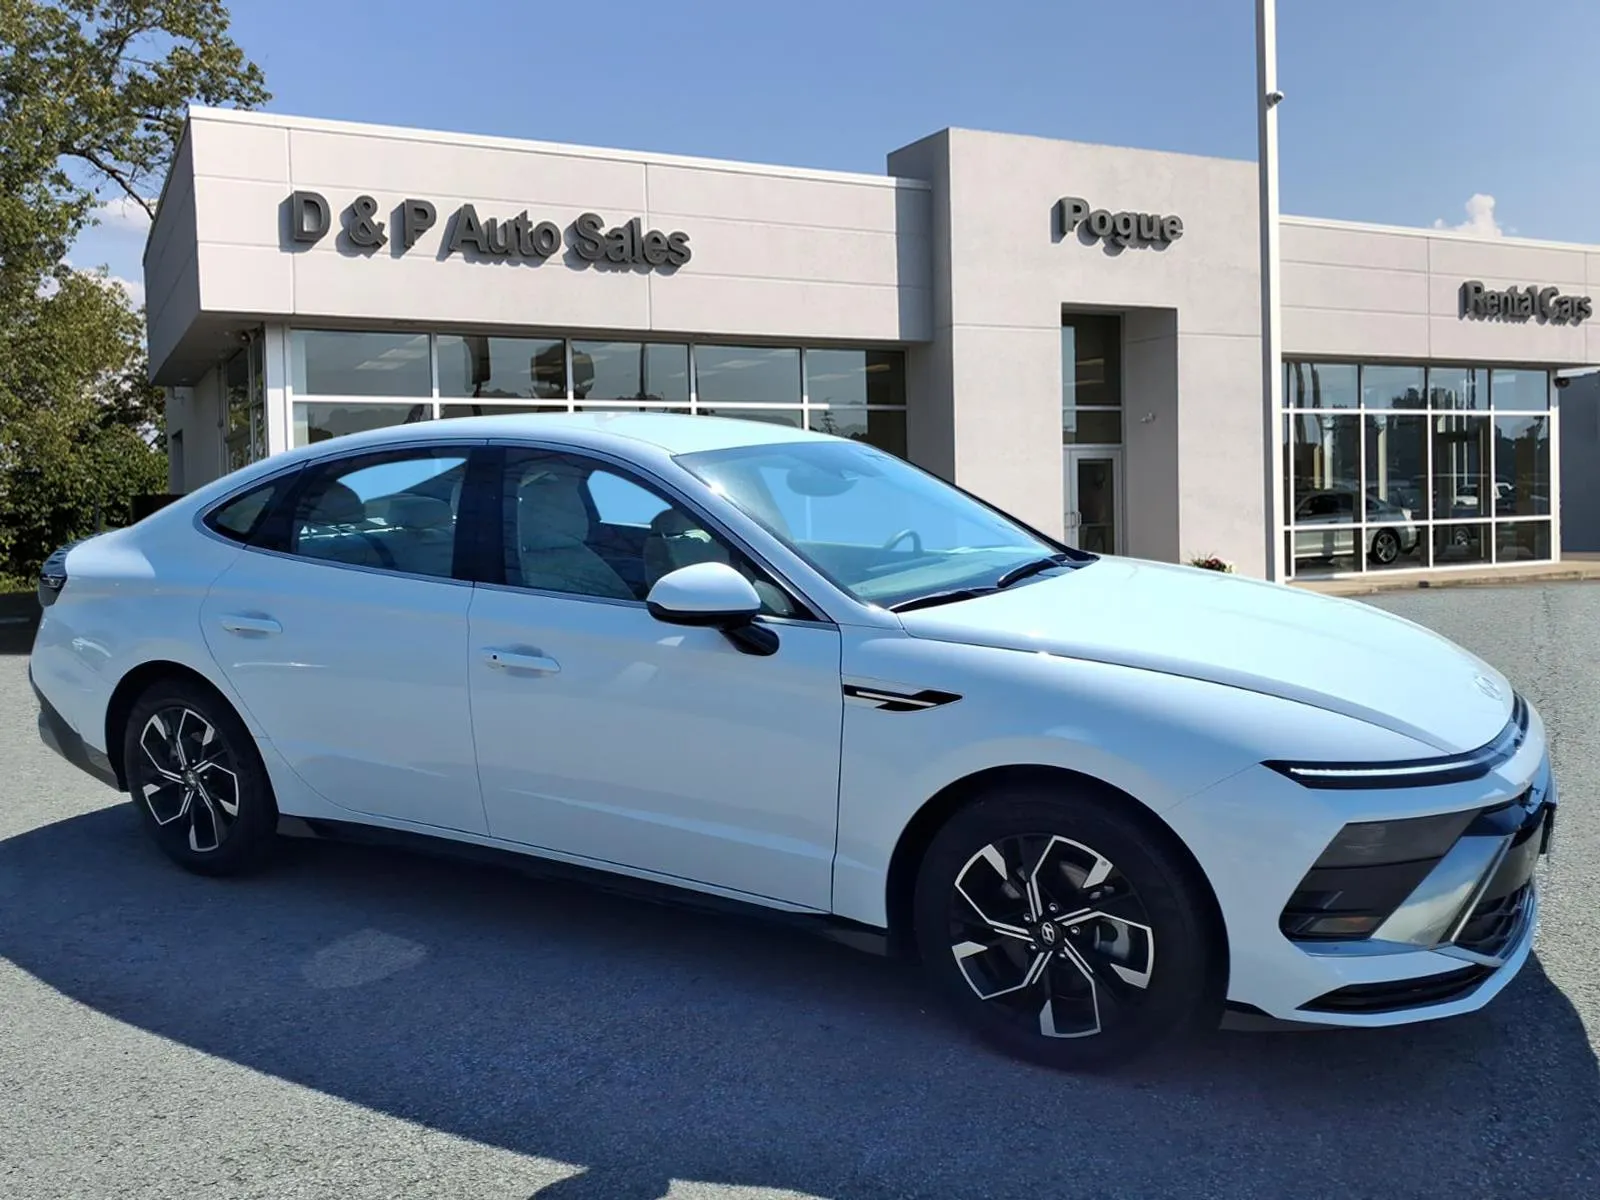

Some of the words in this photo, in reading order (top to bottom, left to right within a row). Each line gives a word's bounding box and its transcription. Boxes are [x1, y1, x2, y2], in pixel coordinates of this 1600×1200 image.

[286, 190, 331, 246] D
[343, 195, 388, 252] &
[398, 199, 437, 250] P
[442, 204, 561, 261] Auto
[569, 213, 691, 270] Sales
[1056, 197, 1183, 251] Pogue
[1461, 281, 1537, 320] Rental
[1539, 287, 1592, 322] Cars
